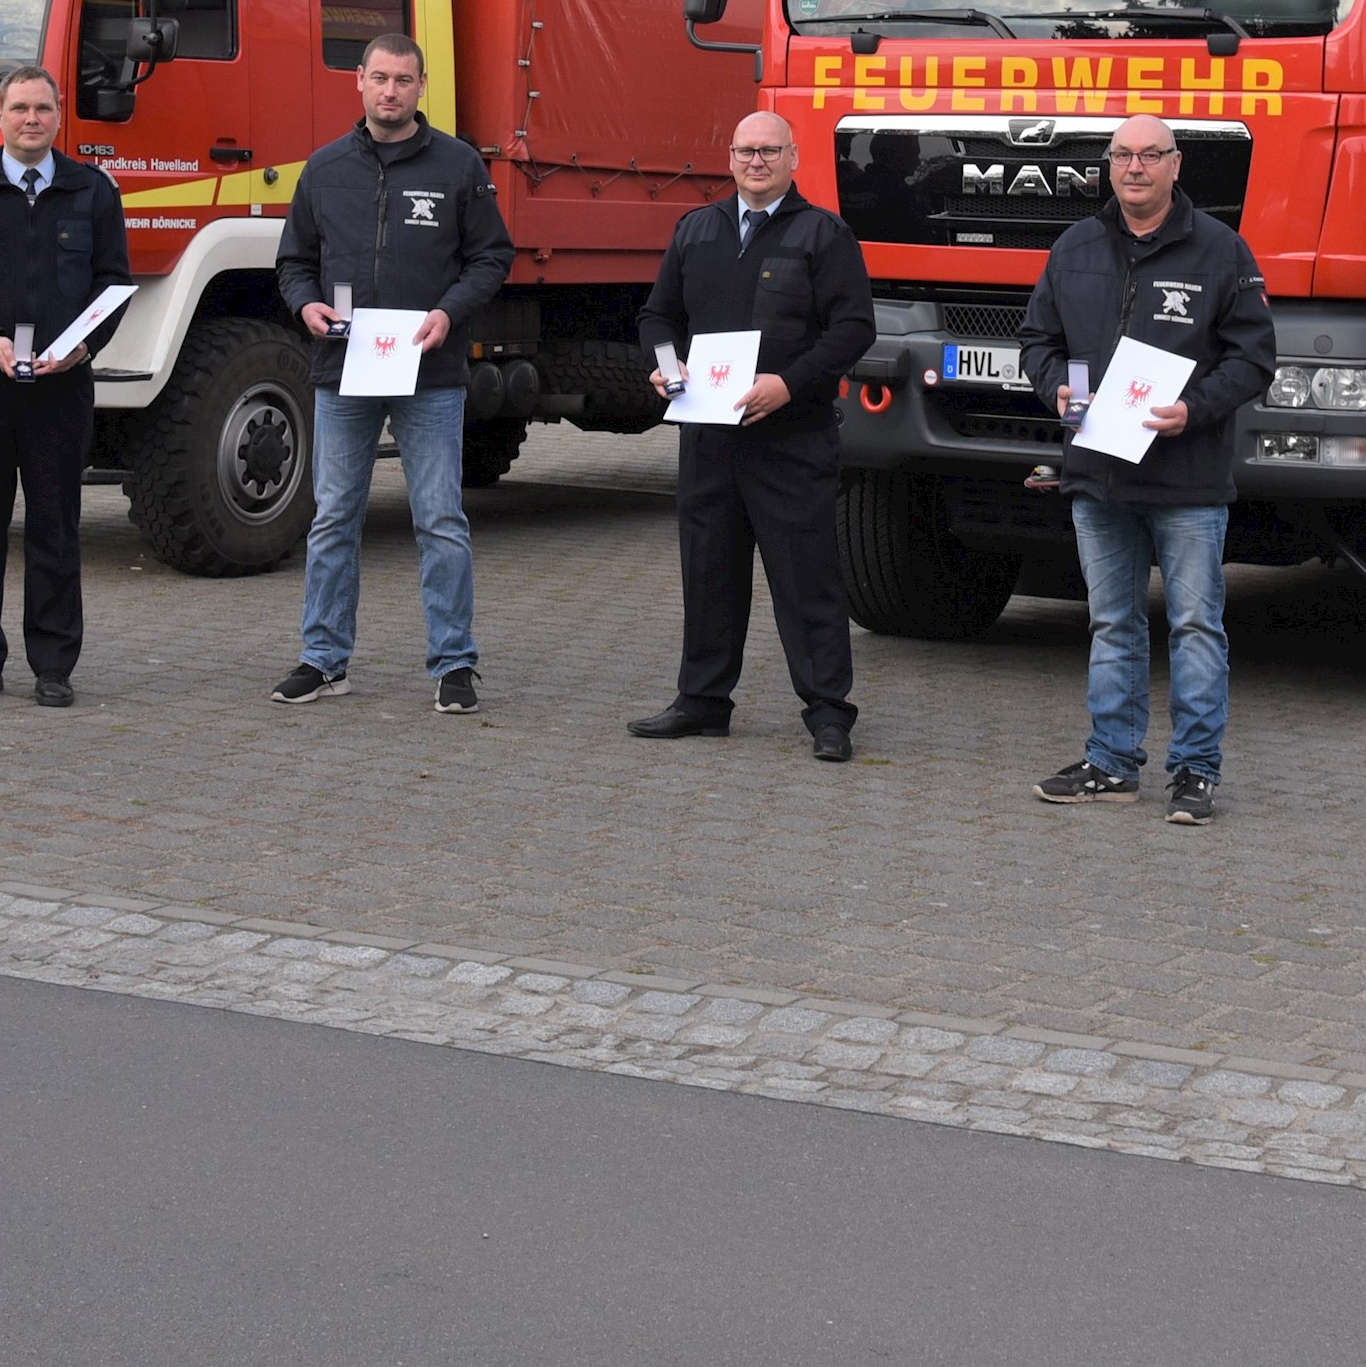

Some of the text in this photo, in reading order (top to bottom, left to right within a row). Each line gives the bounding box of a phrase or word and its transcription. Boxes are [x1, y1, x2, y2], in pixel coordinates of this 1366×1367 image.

[812, 56, 1284, 116] FEUERWEHR
[95, 156, 198, 172] Landkreis Havelland
[962, 163, 1101, 197] MAN
[124, 215, 197, 229] WEHR BÖRNICKE
[959, 350, 999, 378] HVL
